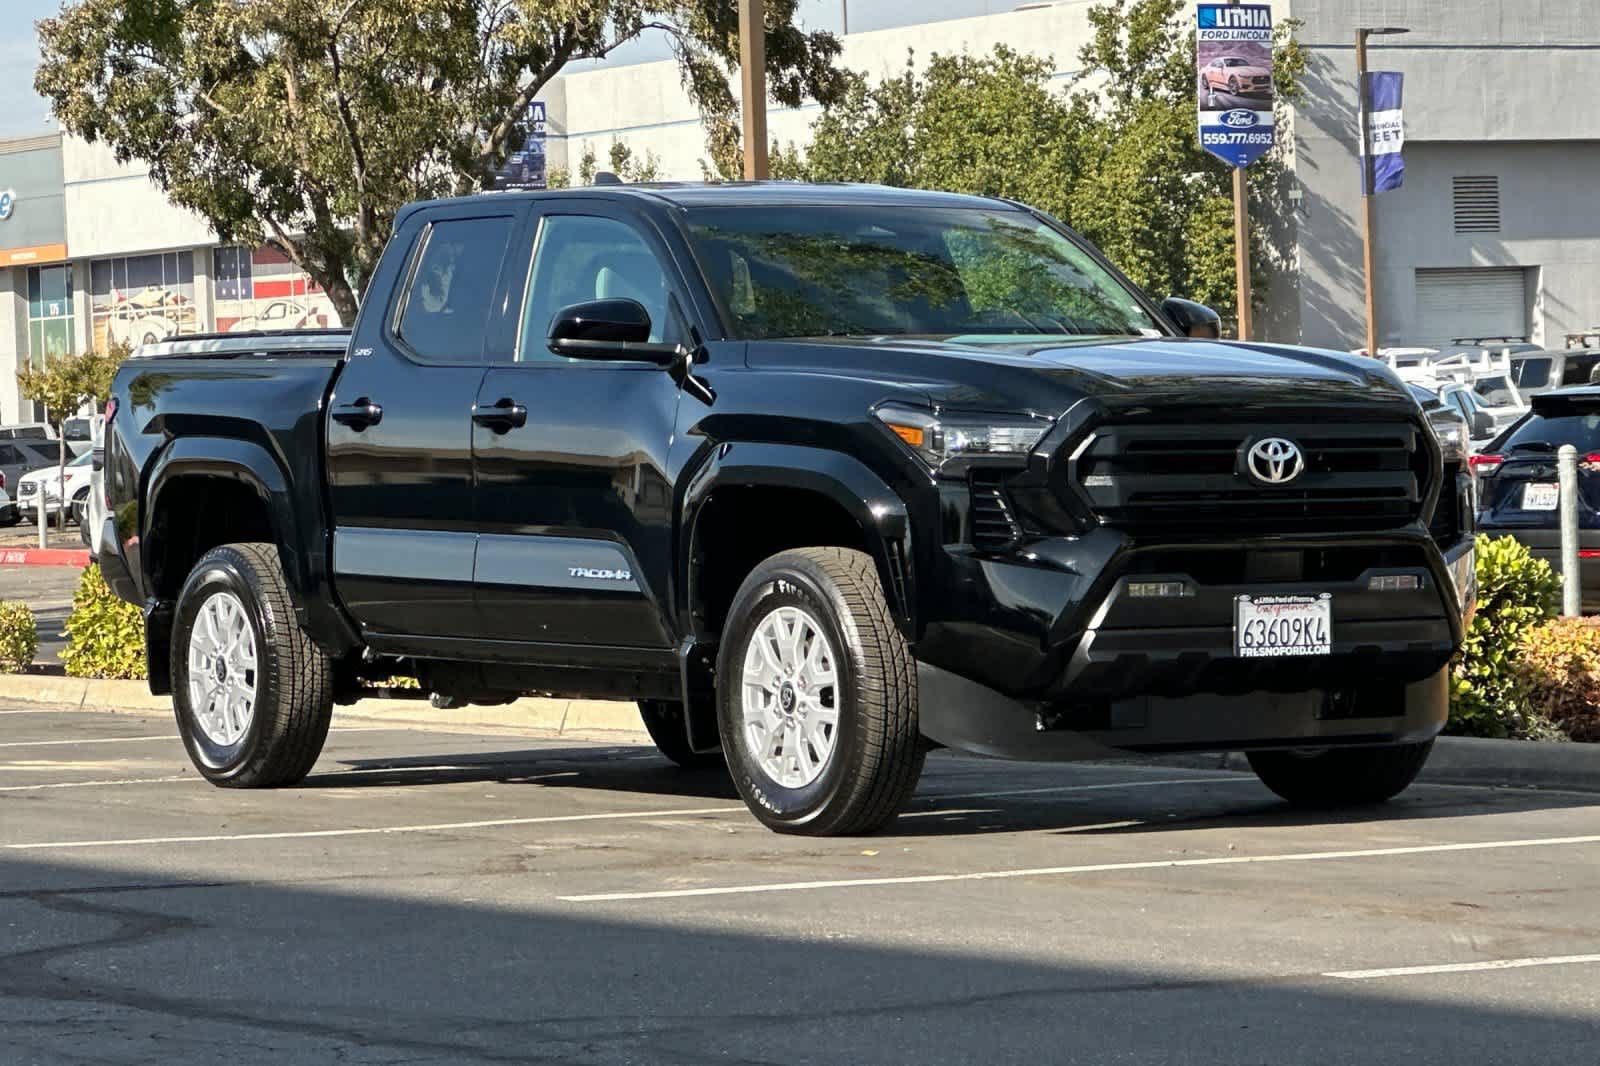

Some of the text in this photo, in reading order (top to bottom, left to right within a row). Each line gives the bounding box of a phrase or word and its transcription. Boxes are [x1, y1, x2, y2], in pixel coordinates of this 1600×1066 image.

[1215, 8, 1270, 28] LITHIA
[1201, 30, 1270, 40] FORD LINCOLN
[1226, 111, 1254, 126] Ford
[1203, 133, 1272, 145] 559.777.6952
[1373, 129, 1401, 142] EET
[568, 567, 632, 580] TACOMA
[1243, 617, 1326, 647] 63609K4
[1240, 644, 1331, 657] FRESNOFORD.COM
